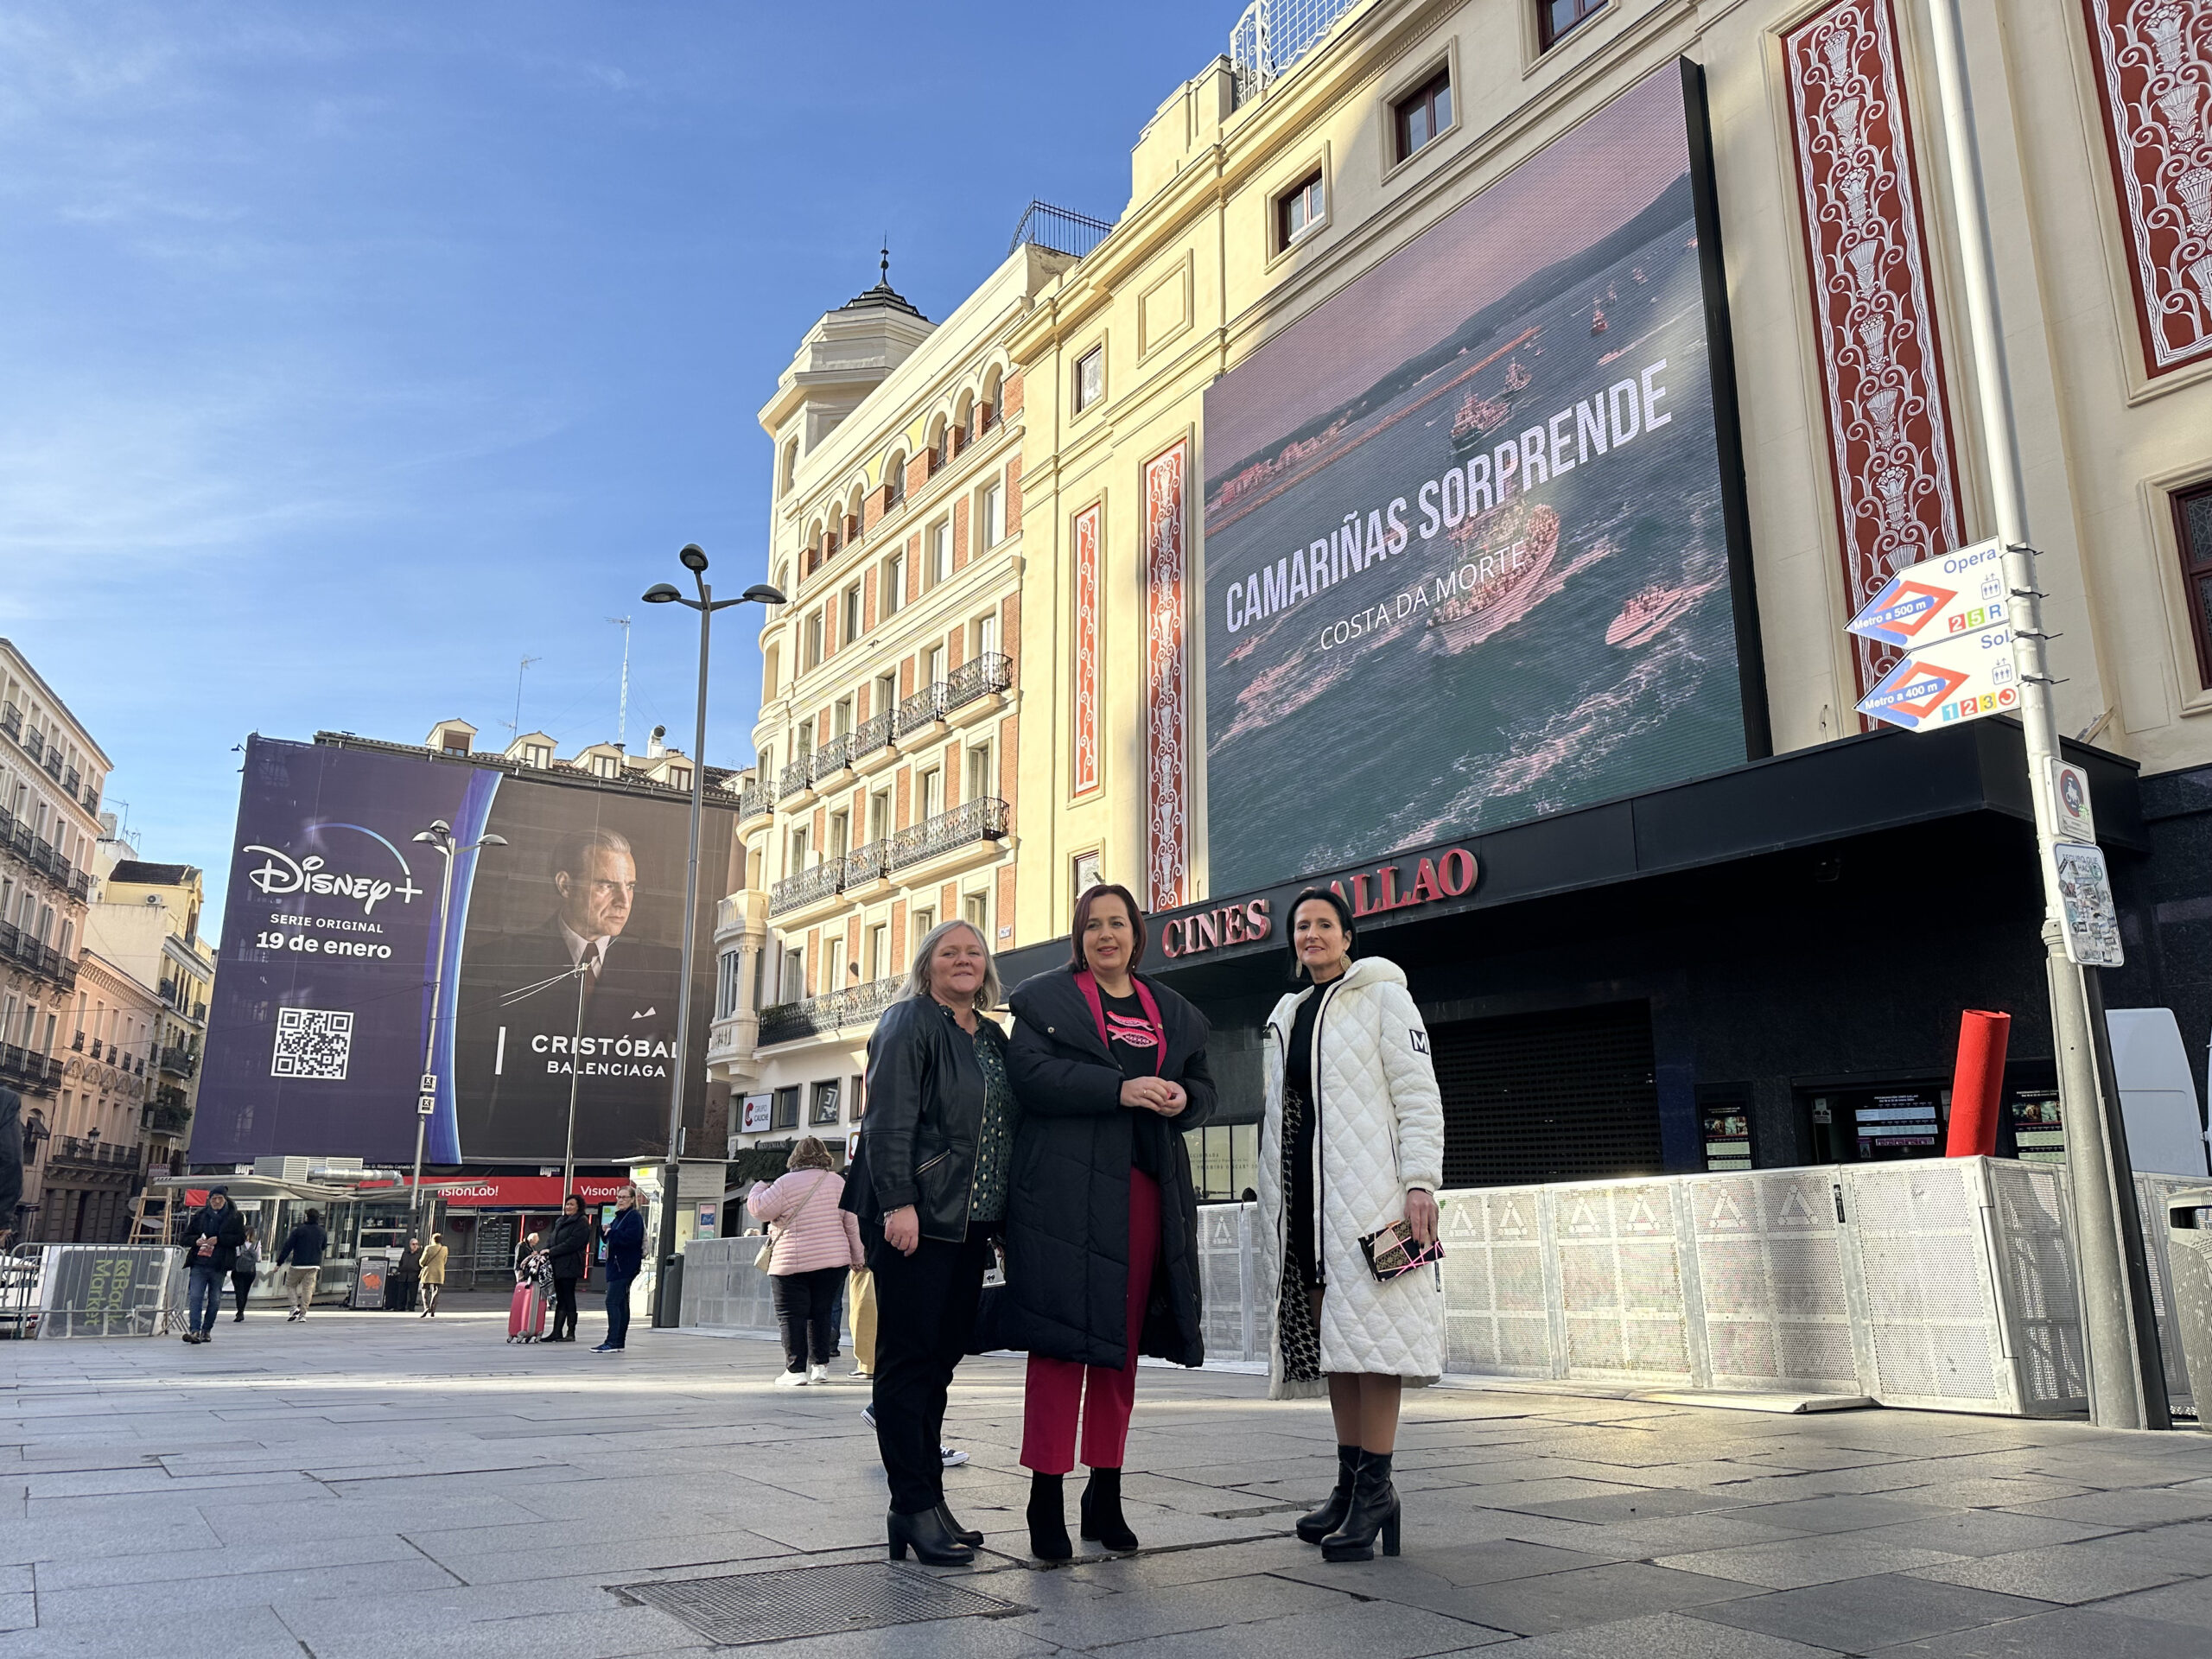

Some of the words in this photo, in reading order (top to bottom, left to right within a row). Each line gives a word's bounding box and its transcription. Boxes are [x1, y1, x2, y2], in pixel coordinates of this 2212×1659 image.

[1225, 496, 1408, 633] CAMARIÑAS
[1417, 358, 1673, 540] SORPRENDE
[1320, 603, 1391, 652] COSTA
[1396, 585, 1429, 620] DA
[1435, 541, 1527, 602] MORTE
[1853, 615, 1884, 631] Metro
[1885, 612, 1892, 621] a
[1894, 605, 1915, 618] 500
[1916, 601, 1927, 610] m
[1950, 616, 1964, 632] 2
[1969, 610, 1983, 625] 5
[1989, 604, 2002, 619] R
[1980, 629, 2010, 649] Sol
[1865, 695, 1895, 710] Metro
[1897, 693, 1904, 702] a
[1905, 685, 1925, 698] 400
[1927, 683, 1938, 692] m
[1946, 705, 1956, 719] 1
[1962, 700, 1976, 715] 2
[1982, 694, 1994, 709] 3
[1161, 898, 1272, 958] CINES
[1326, 848, 1478, 918] ALLAO
[270, 913, 312, 926] SERIE
[315, 918, 384, 933] ORIGINAL
[256, 931, 285, 949] 19
[289, 934, 319, 952] de
[324, 940, 391, 958] enero
